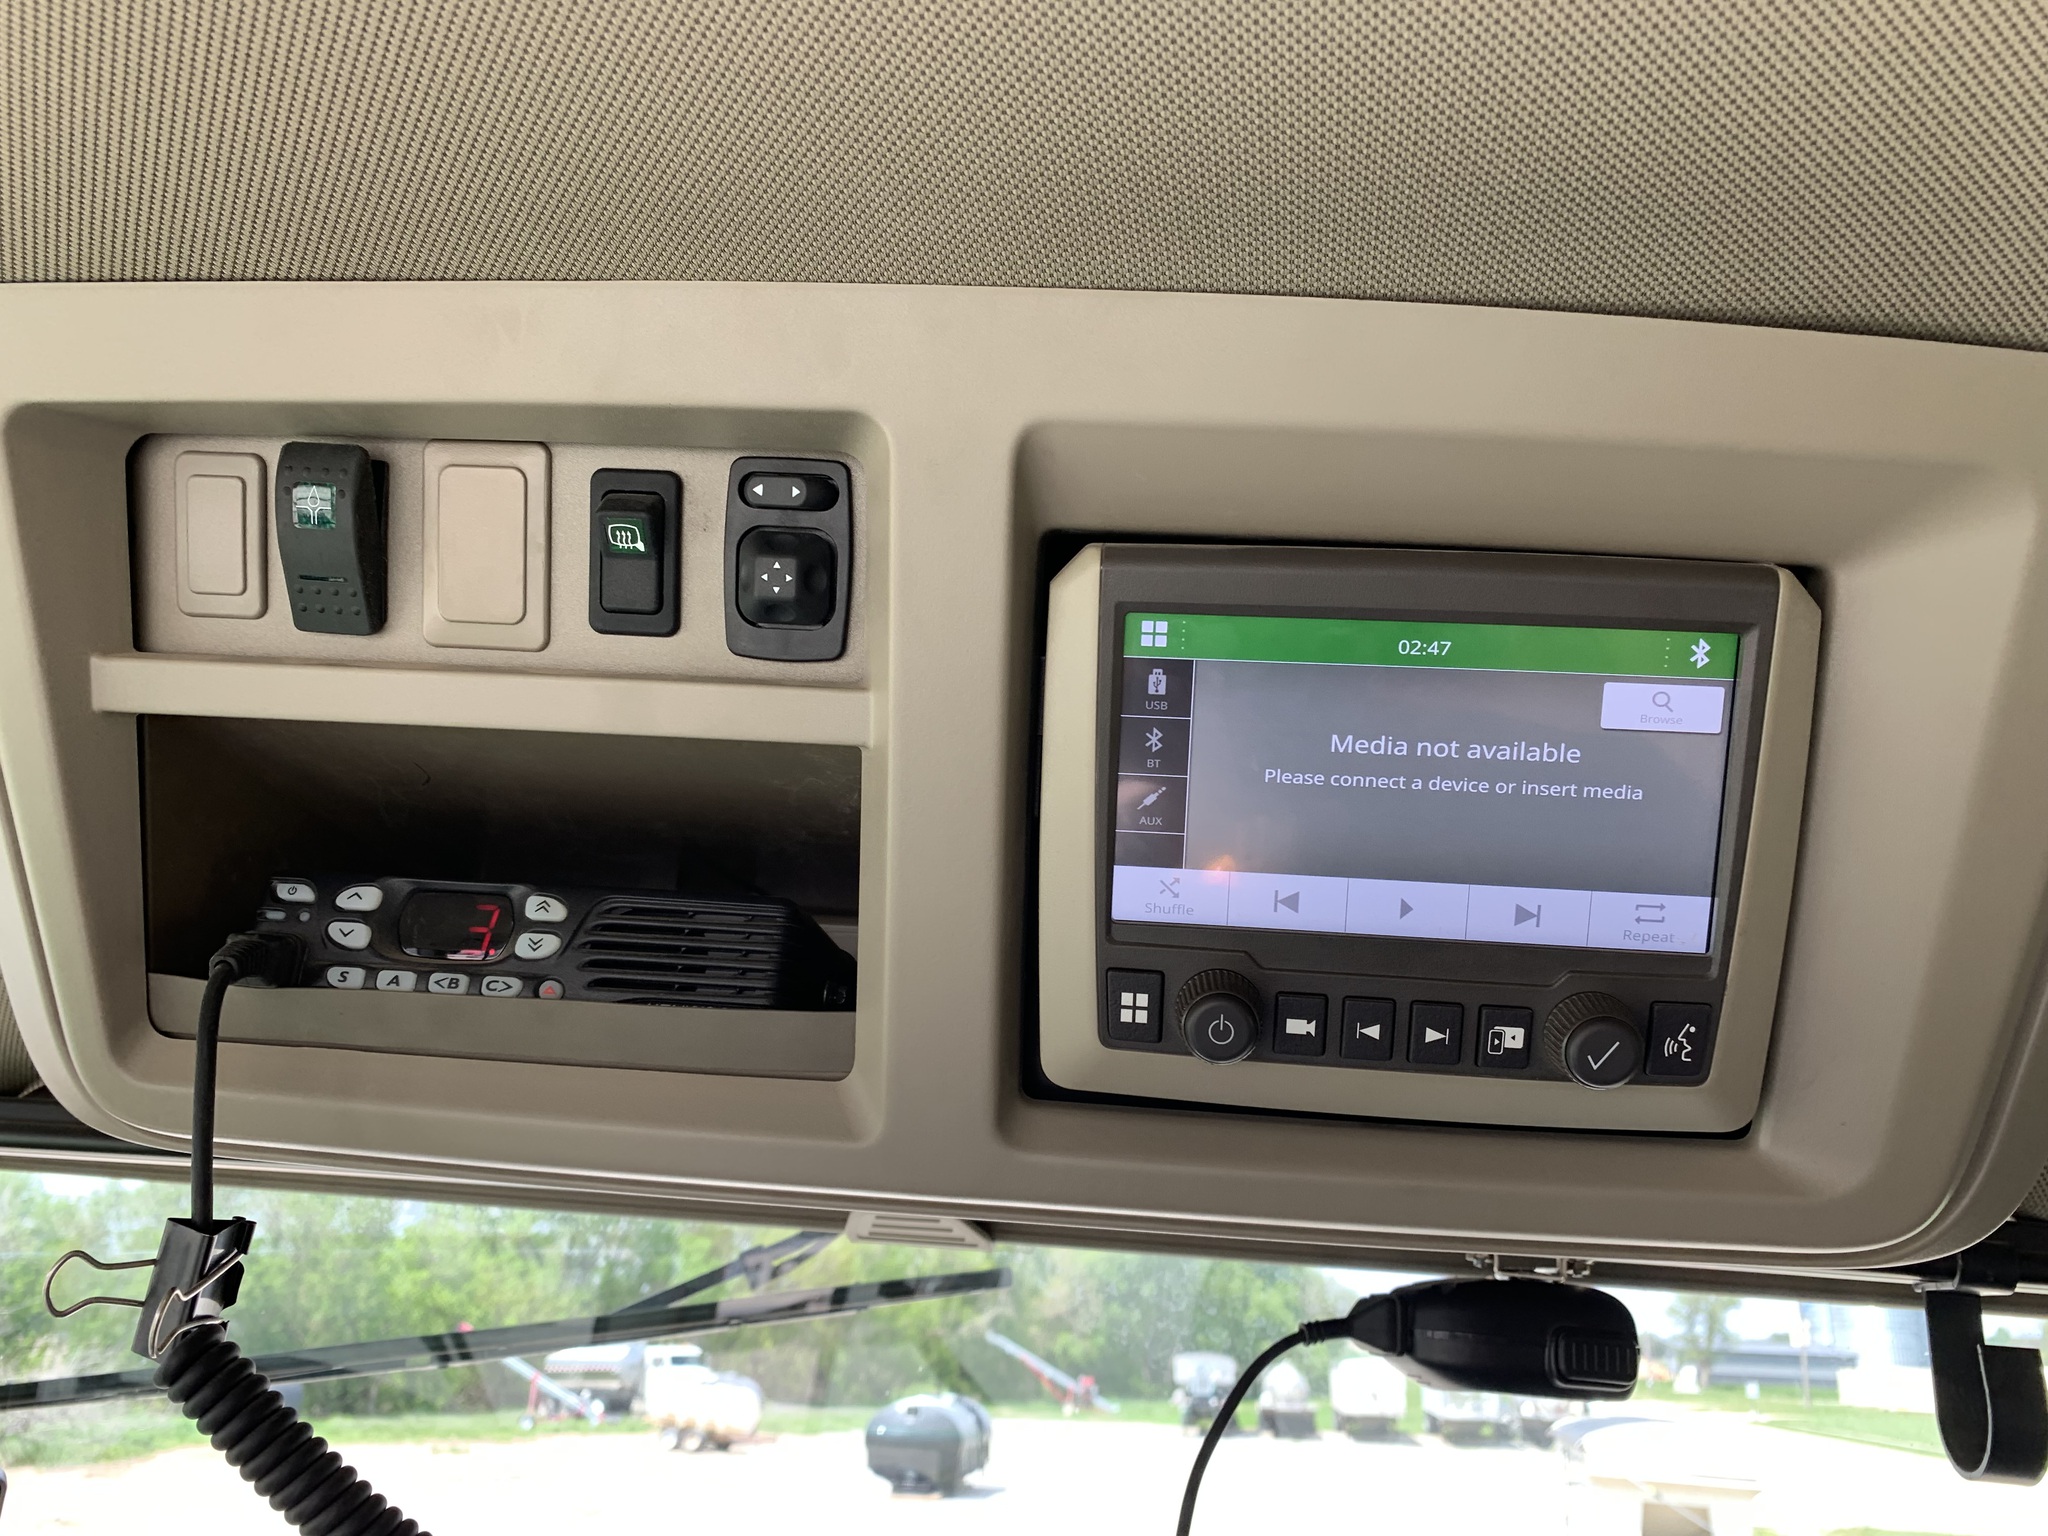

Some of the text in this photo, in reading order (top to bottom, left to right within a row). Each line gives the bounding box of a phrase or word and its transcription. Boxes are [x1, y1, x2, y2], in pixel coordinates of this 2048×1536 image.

[1398, 639, 1452, 656] 02:47
[1145, 700, 1168, 711] USB
[1640, 714, 1683, 726] Browse
[1331, 734, 1581, 763] Media not available
[1146, 758, 1161, 769] BT
[1264, 769, 1643, 800] Please connect a device or insert media
[1139, 816, 1163, 826] AUX
[1144, 902, 1194, 917] Shuffle
[1623, 929, 1675, 945] Repeat
[337, 970, 350, 983] S
[386, 974, 401, 987] A
